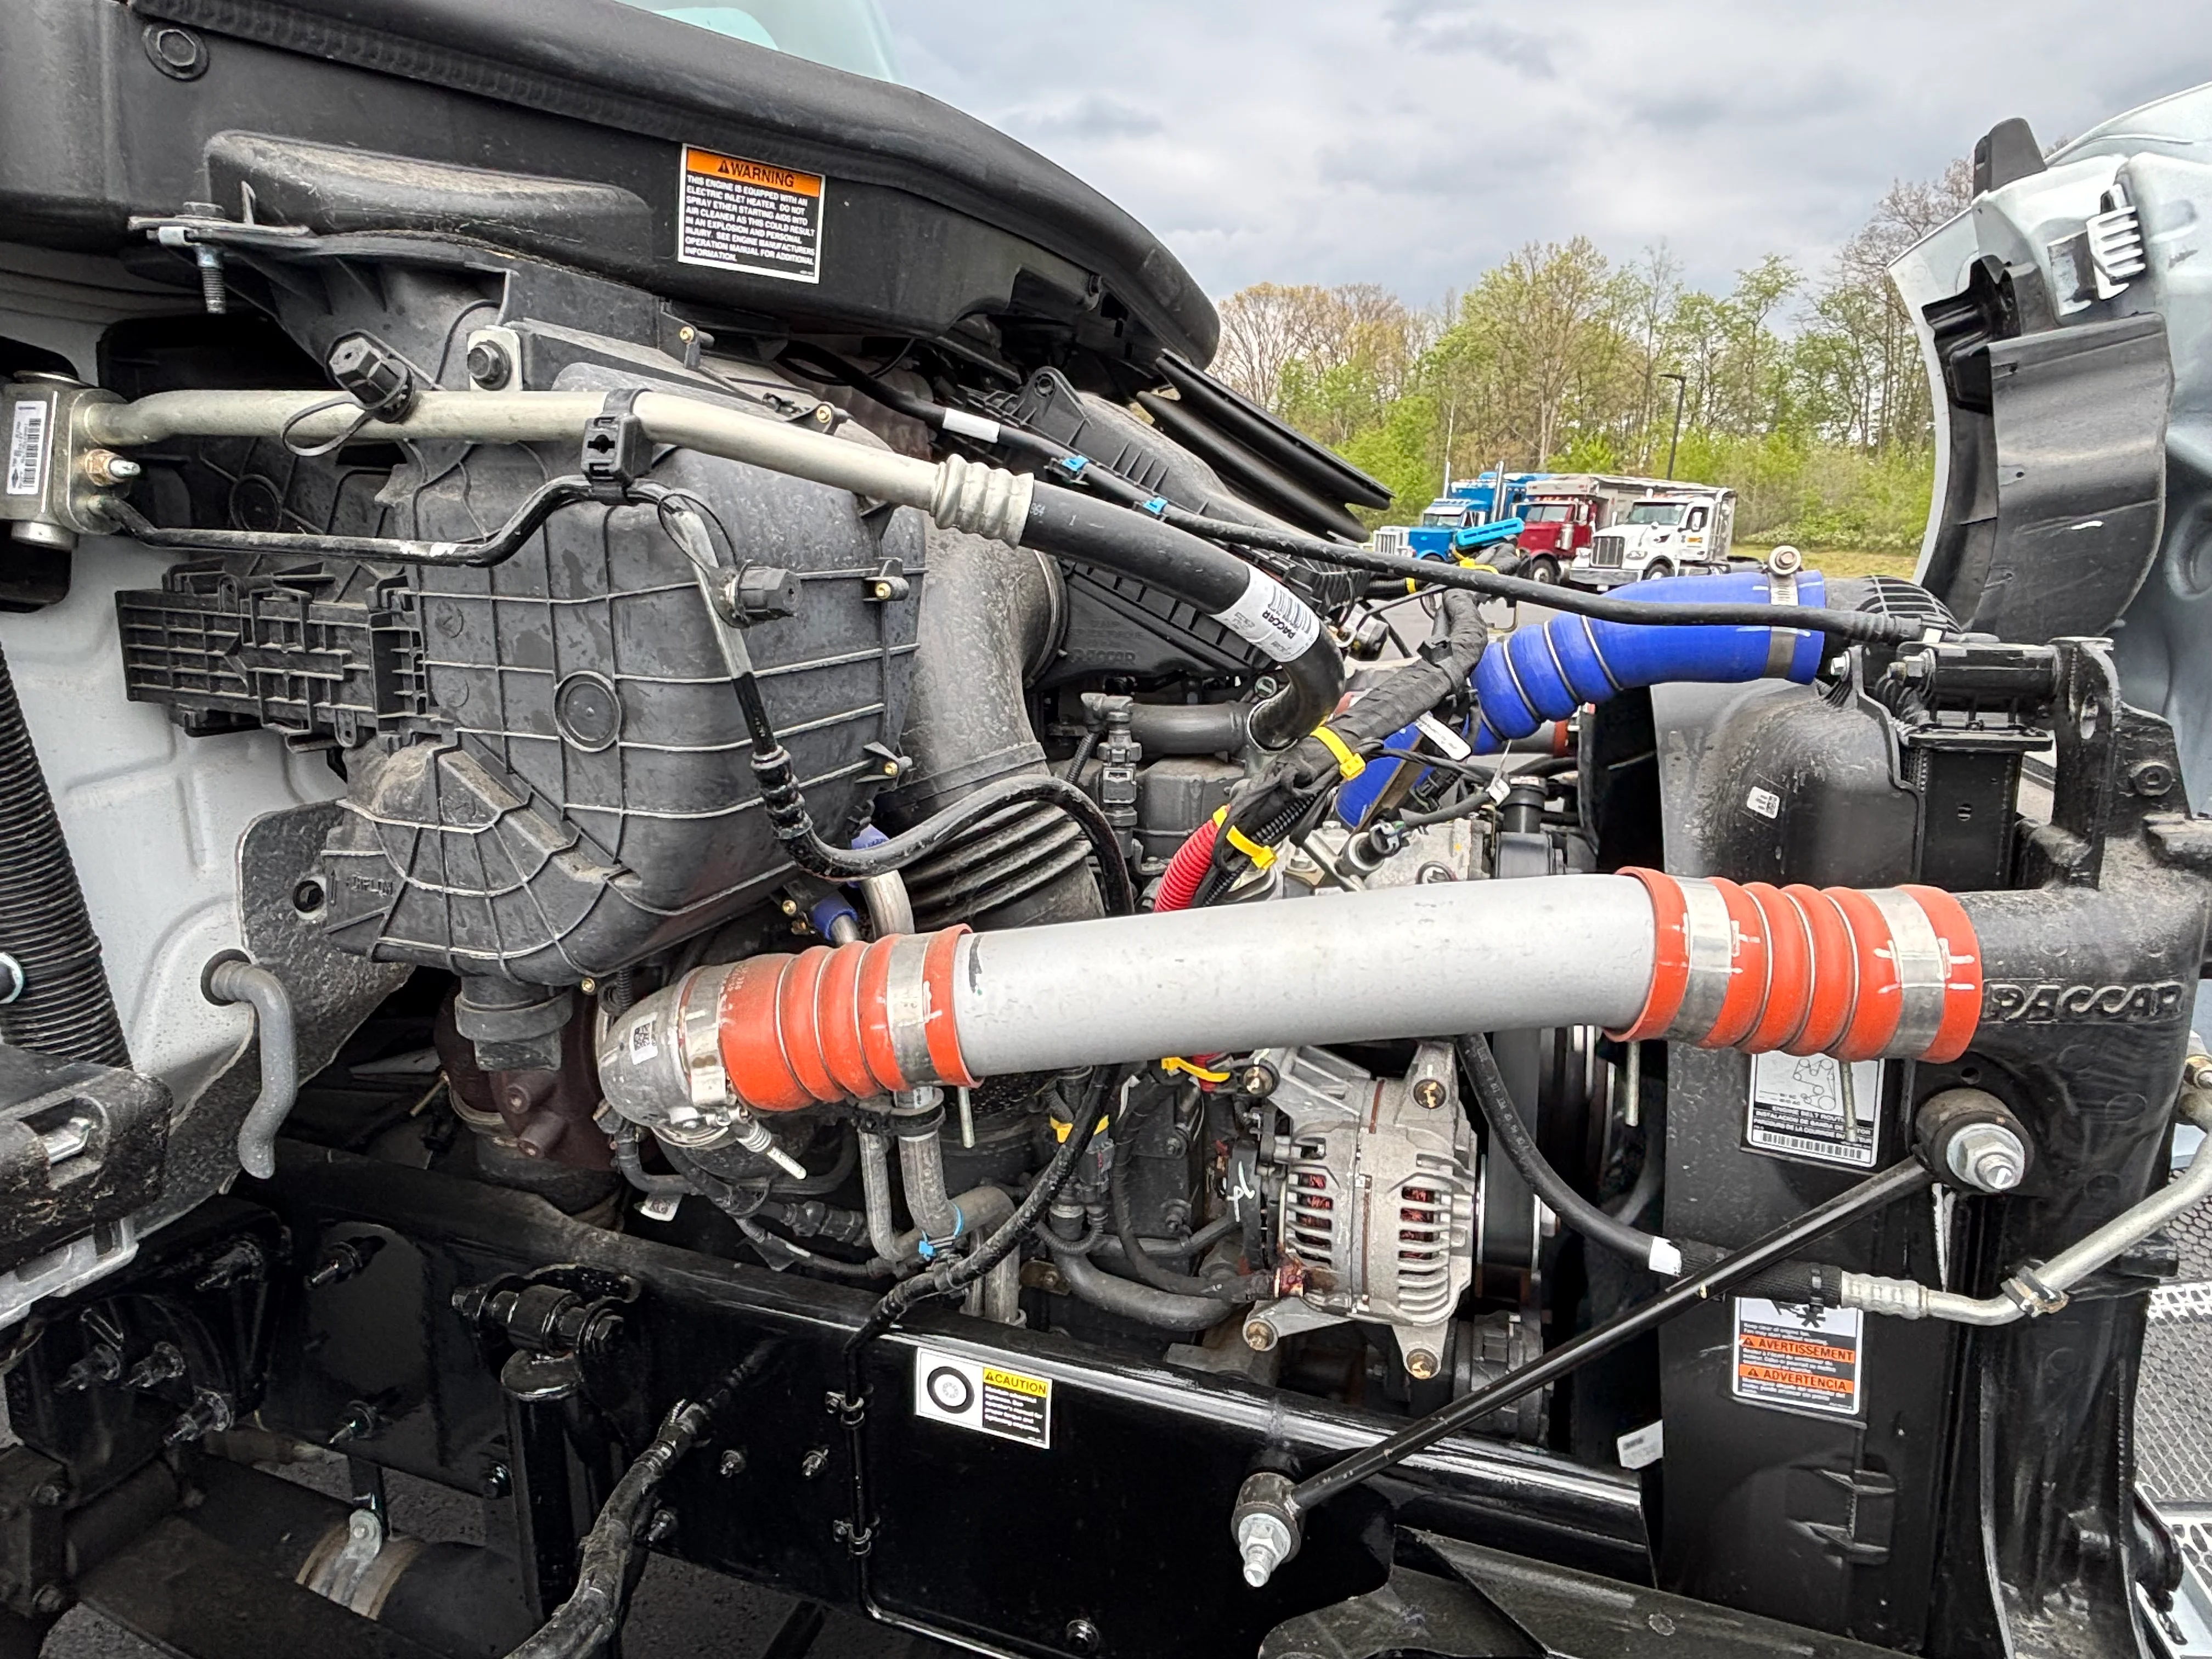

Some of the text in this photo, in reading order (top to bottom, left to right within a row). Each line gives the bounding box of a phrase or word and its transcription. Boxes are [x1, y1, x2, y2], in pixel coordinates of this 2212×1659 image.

[731, 161, 794, 188] WARNING
[687, 175, 704, 185] THIS
[706, 178, 733, 191] ENGINE
[743, 186, 778, 200] EQUIPPED
[780, 194, 797, 204] WITH
[687, 185, 805, 215] ELECTRIC INLET HEATER. DO NOT
[686, 196, 808, 225] SPRAY ETHER STARTING AIDS INTO
[686, 206, 815, 236] AIR CLEANER AS THIS COULD RESULT
[686, 216, 802, 244] IN AN EXPLOSION AND PERSONAL
[685, 236, 814, 265] OPERATION MANUAL FOR ADDITIONAL
[1262, 610, 1295, 639] PACCAR
[1984, 981, 2184, 1022] PACCAR
[1759, 1339, 1853, 1361] AVERTISSEMENT
[995, 1374, 1046, 1395] CAUTION
[1764, 1369, 1847, 1391] ADVERTENCIA
